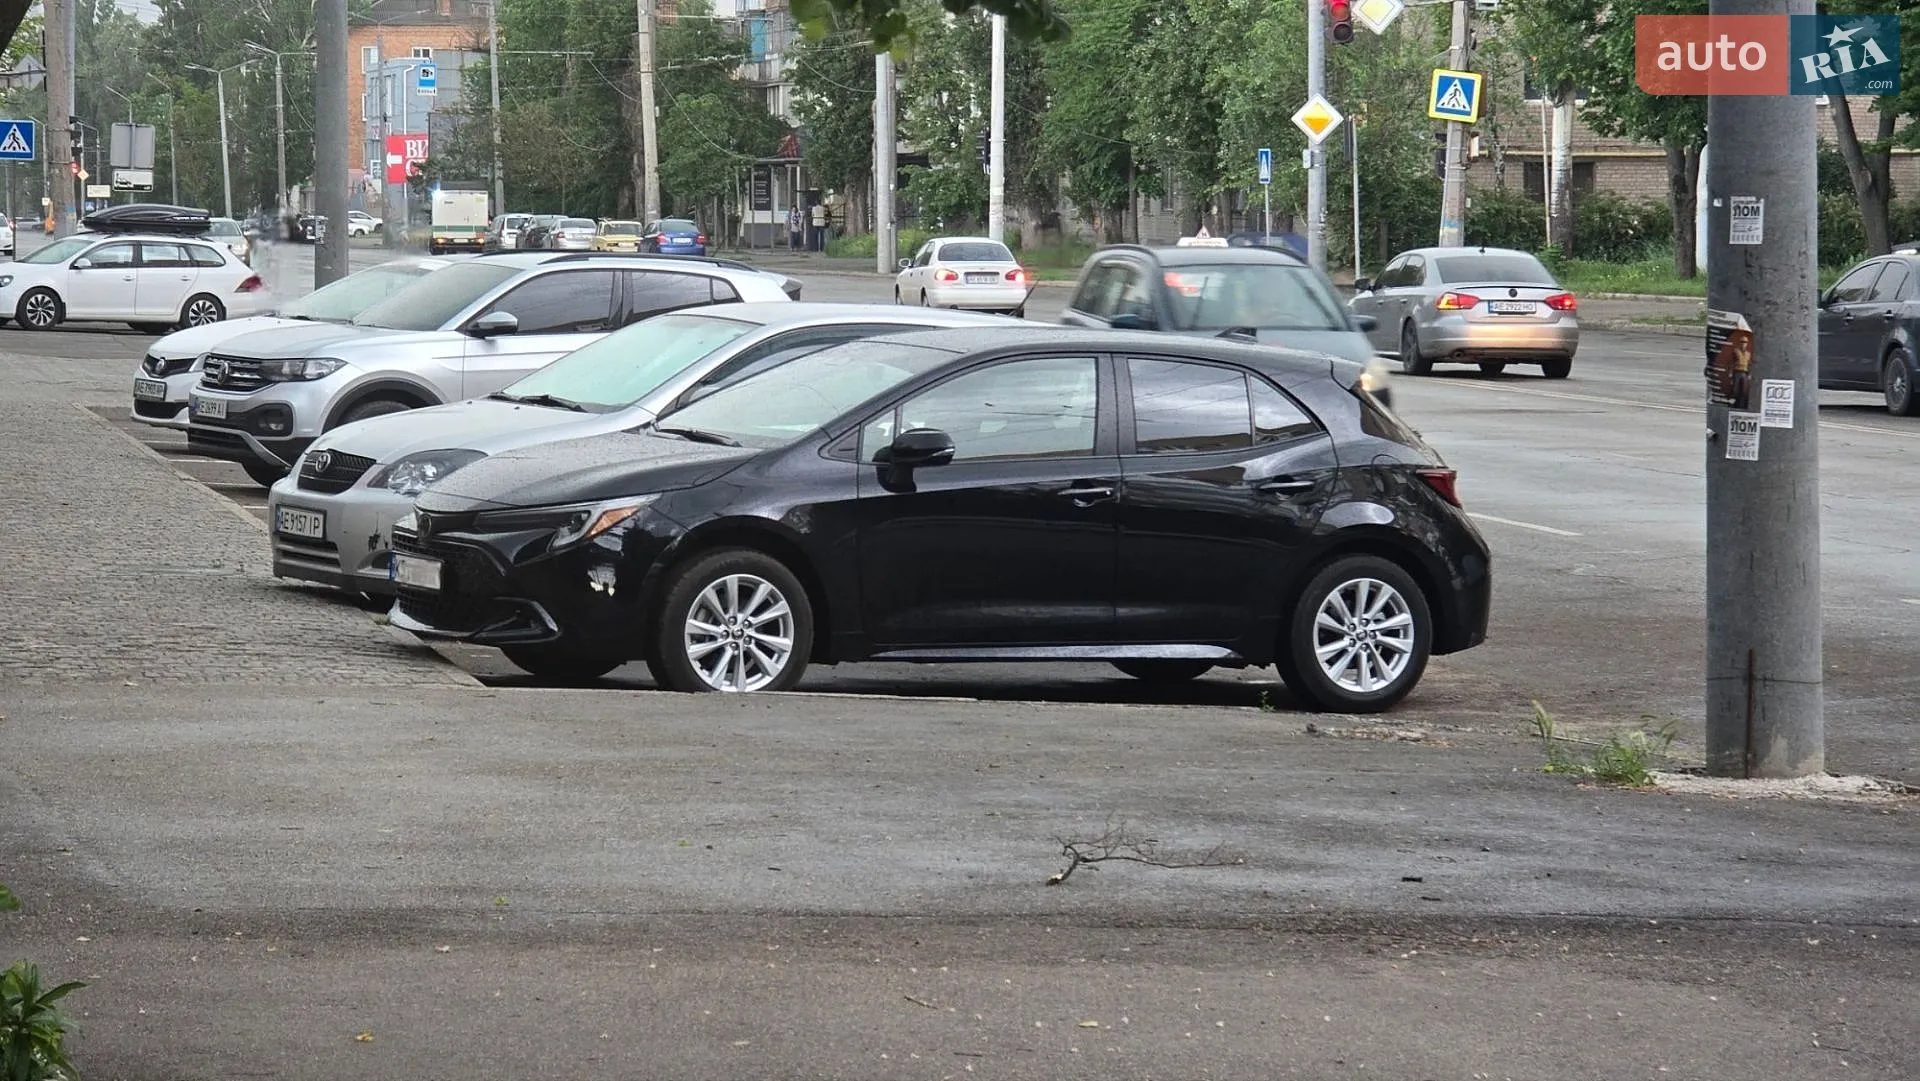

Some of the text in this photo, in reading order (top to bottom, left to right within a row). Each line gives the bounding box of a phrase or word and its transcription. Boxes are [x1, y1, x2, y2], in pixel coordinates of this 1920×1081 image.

[278, 511, 320, 536] AE 9157 IP
